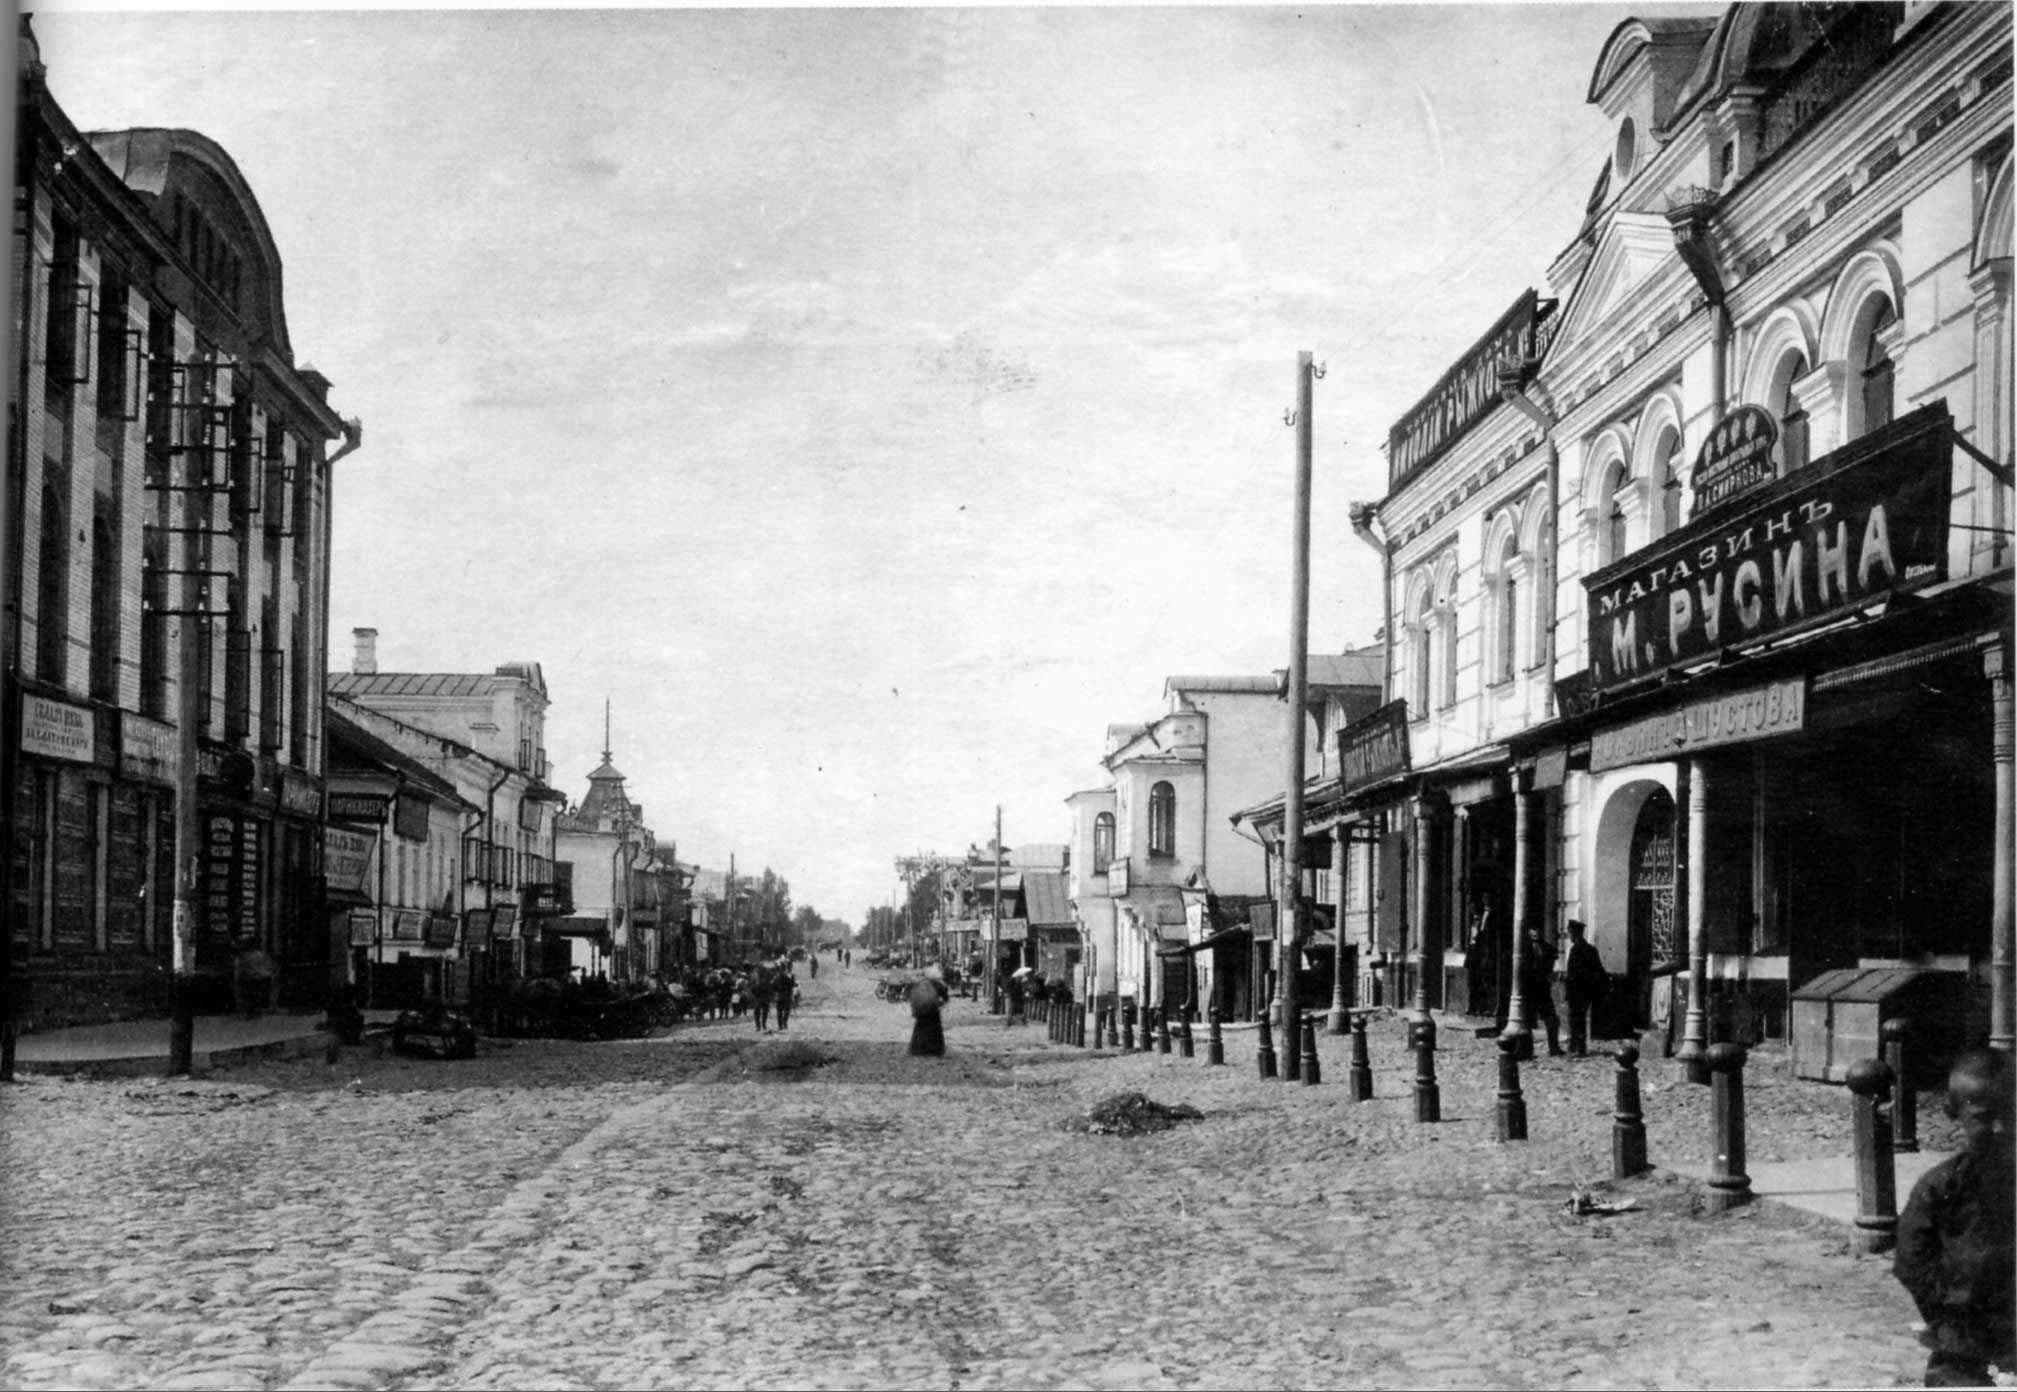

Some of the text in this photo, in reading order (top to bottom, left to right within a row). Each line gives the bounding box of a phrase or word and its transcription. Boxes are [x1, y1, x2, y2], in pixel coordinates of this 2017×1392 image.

[1600, 499, 1833, 616] МАГАЗИНЪ
[1612, 504, 1897, 676] М. РУСИНА
[1687, 682, 1801, 744] ШУСТОВА
